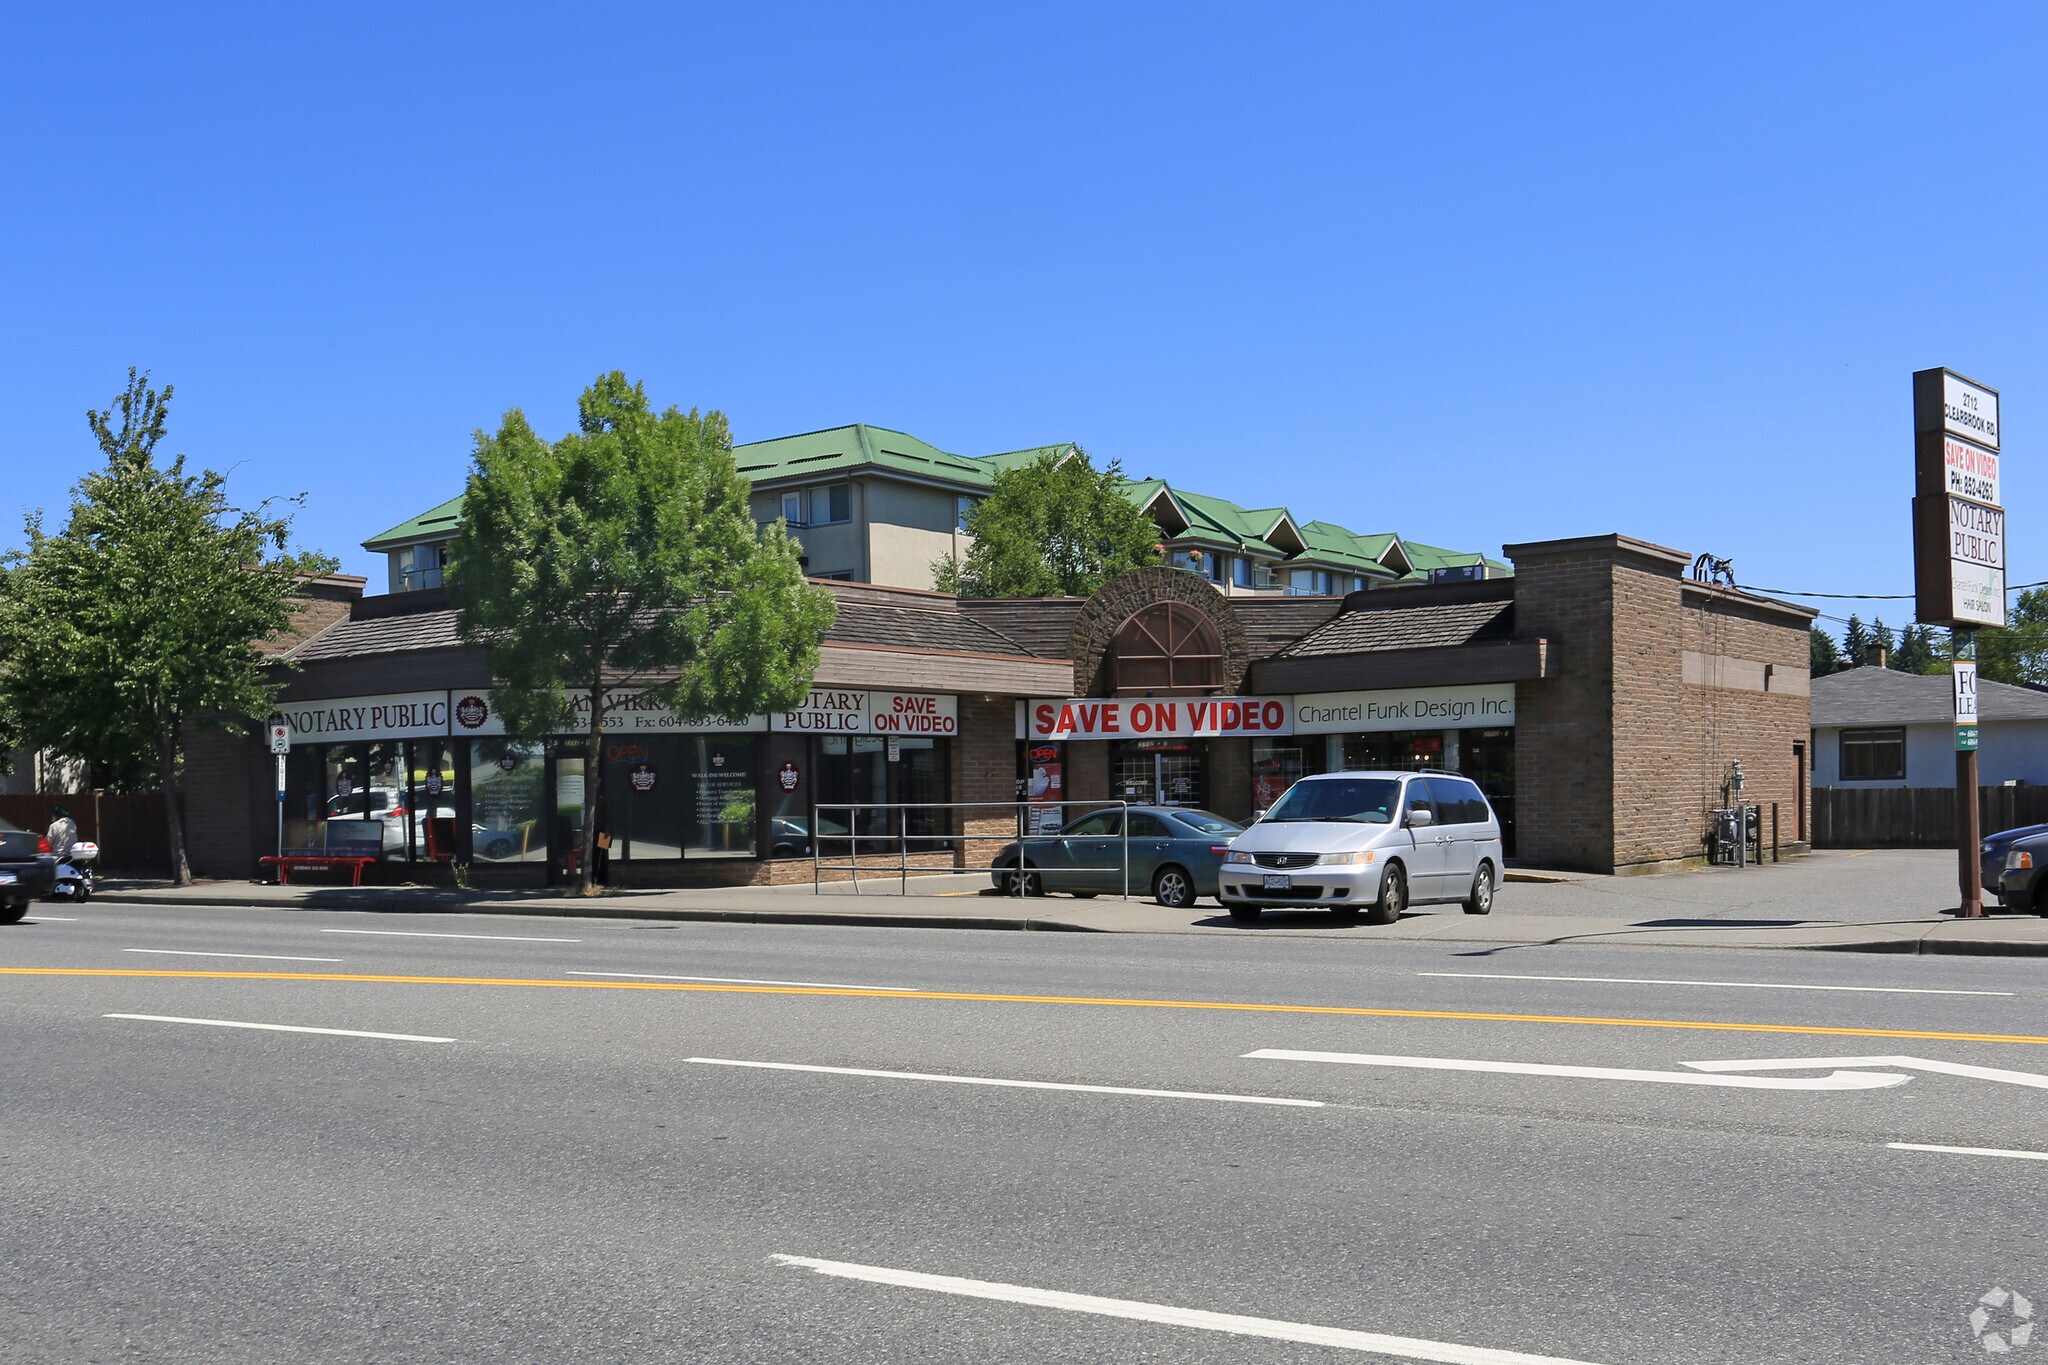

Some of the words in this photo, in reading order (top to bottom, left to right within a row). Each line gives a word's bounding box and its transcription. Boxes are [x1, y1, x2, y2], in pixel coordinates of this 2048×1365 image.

[1963, 392, 1978, 411] 2712
[1945, 403, 1986, 433] CLEARBROOK
[1986, 421, 1997, 438] RD.
[1946, 441, 1964, 470] SAVE
[1966, 448, 1975, 474] ON
[1976, 452, 1996, 480] VIDEO
[1951, 470, 1962, 492] PH:
[1964, 476, 1994, 502] 852-4263
[1950, 500, 2002, 536] NOTARY
[1954, 532, 1997, 564] PUBLIC
[284, 707, 365, 734] NOTARY
[371, 702, 446, 730] PUBLIC
[893, 696, 936, 714] SAVE
[1035, 703, 1120, 734] SAVE
[1130, 702, 1176, 733] ON
[1186, 700, 1285, 732] VIDEO
[1299, 704, 1362, 723] Chantel
[1368, 701, 1410, 720] Funk
[1415, 699, 1475, 721] Design
[1481, 697, 1512, 715] Inc.
[1958, 697, 1976, 714] LE
[635, 716, 656, 728] Fx:
[784, 712, 860, 730] PUBLIC
[874, 714, 900, 731] ON
[904, 714, 955, 732] VIDEO
[1030, 748, 1057, 760] OPEN
